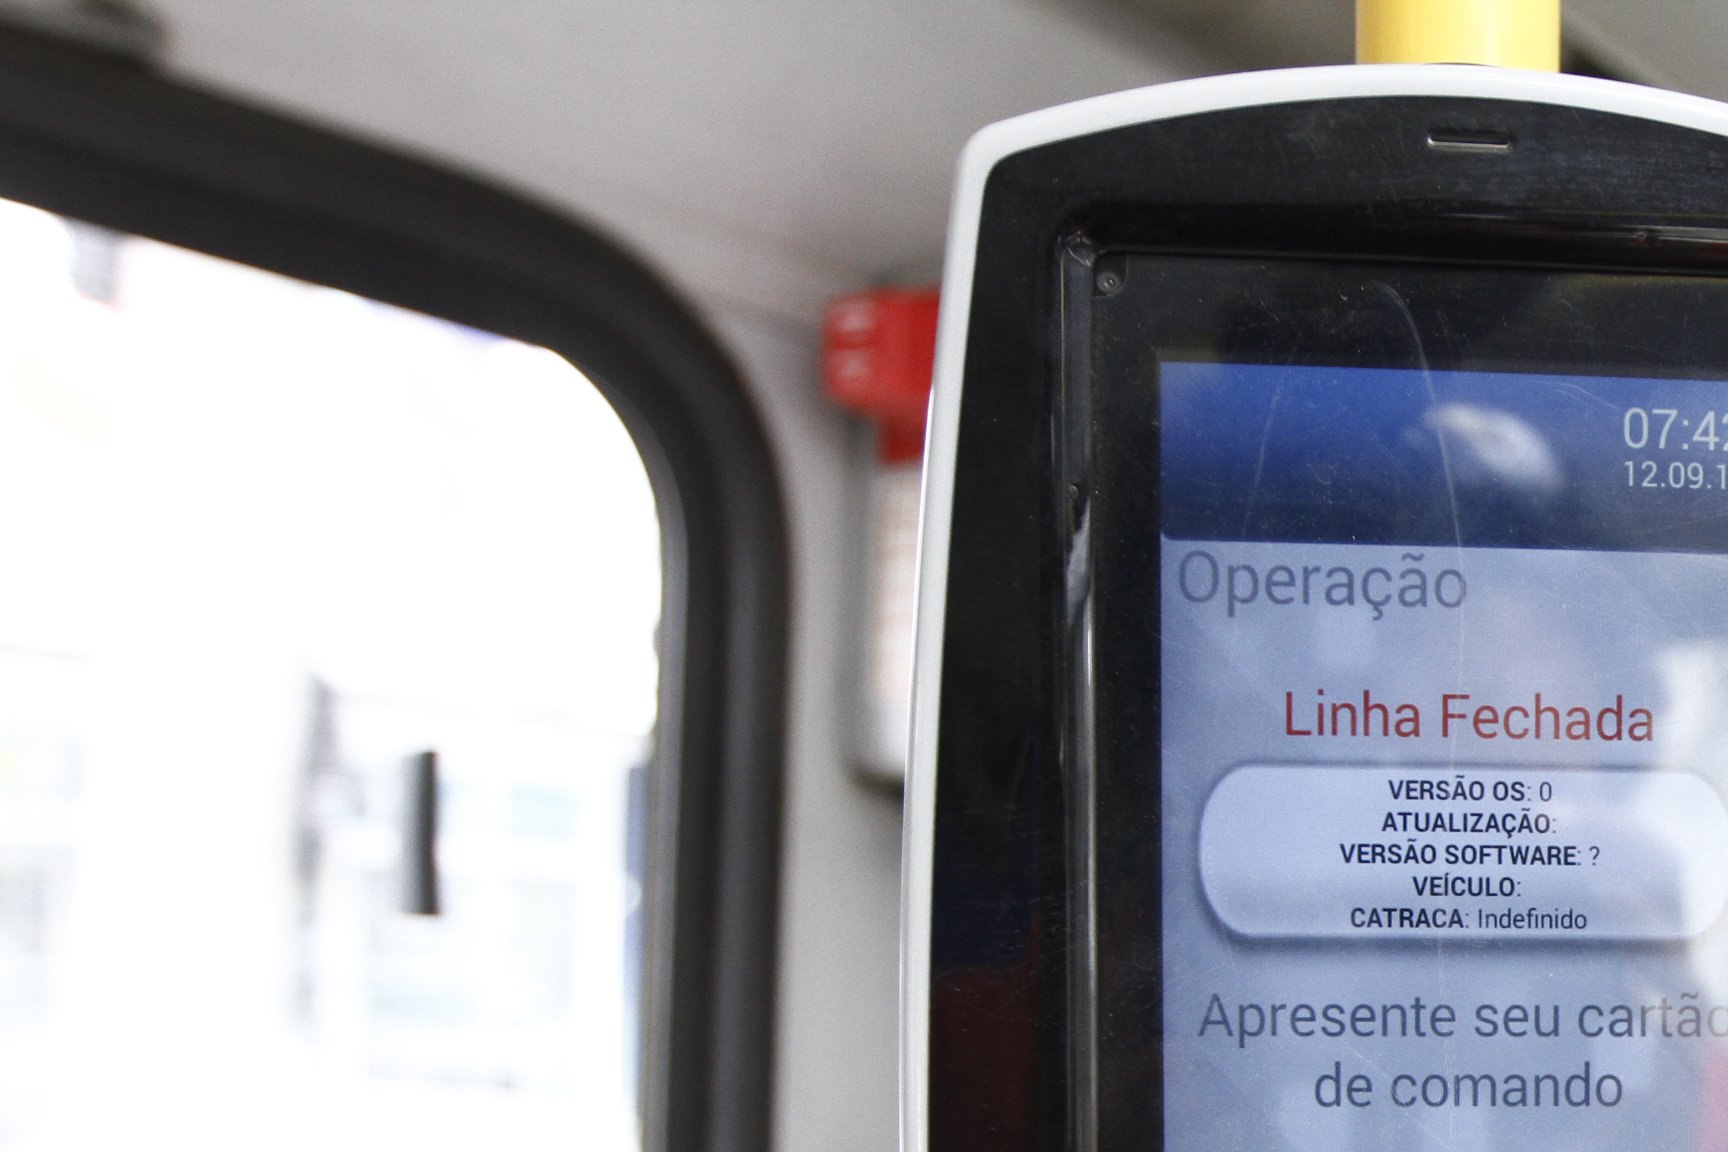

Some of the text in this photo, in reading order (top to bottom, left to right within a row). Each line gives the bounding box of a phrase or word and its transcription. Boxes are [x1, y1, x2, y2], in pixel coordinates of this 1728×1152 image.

[1178, 550, 1467, 620] Operação
[1285, 689, 1655, 742] Linha Fechada
[1388, 775, 1553, 802] VERSÃO OS: 0
[1381, 807, 1557, 840] ATUALIZAÇÃO:
[1340, 839, 1601, 866] VERSÃO SOFTWARE: ?
[1413, 872, 1522, 898] VEÍCULO:
[1350, 908, 1588, 930] CATRACA: Indefinido
[1198, 993, 1456, 1049] Apresente
[1474, 1005, 1560, 1039] seu
[1314, 1061, 1624, 1108] de comando
